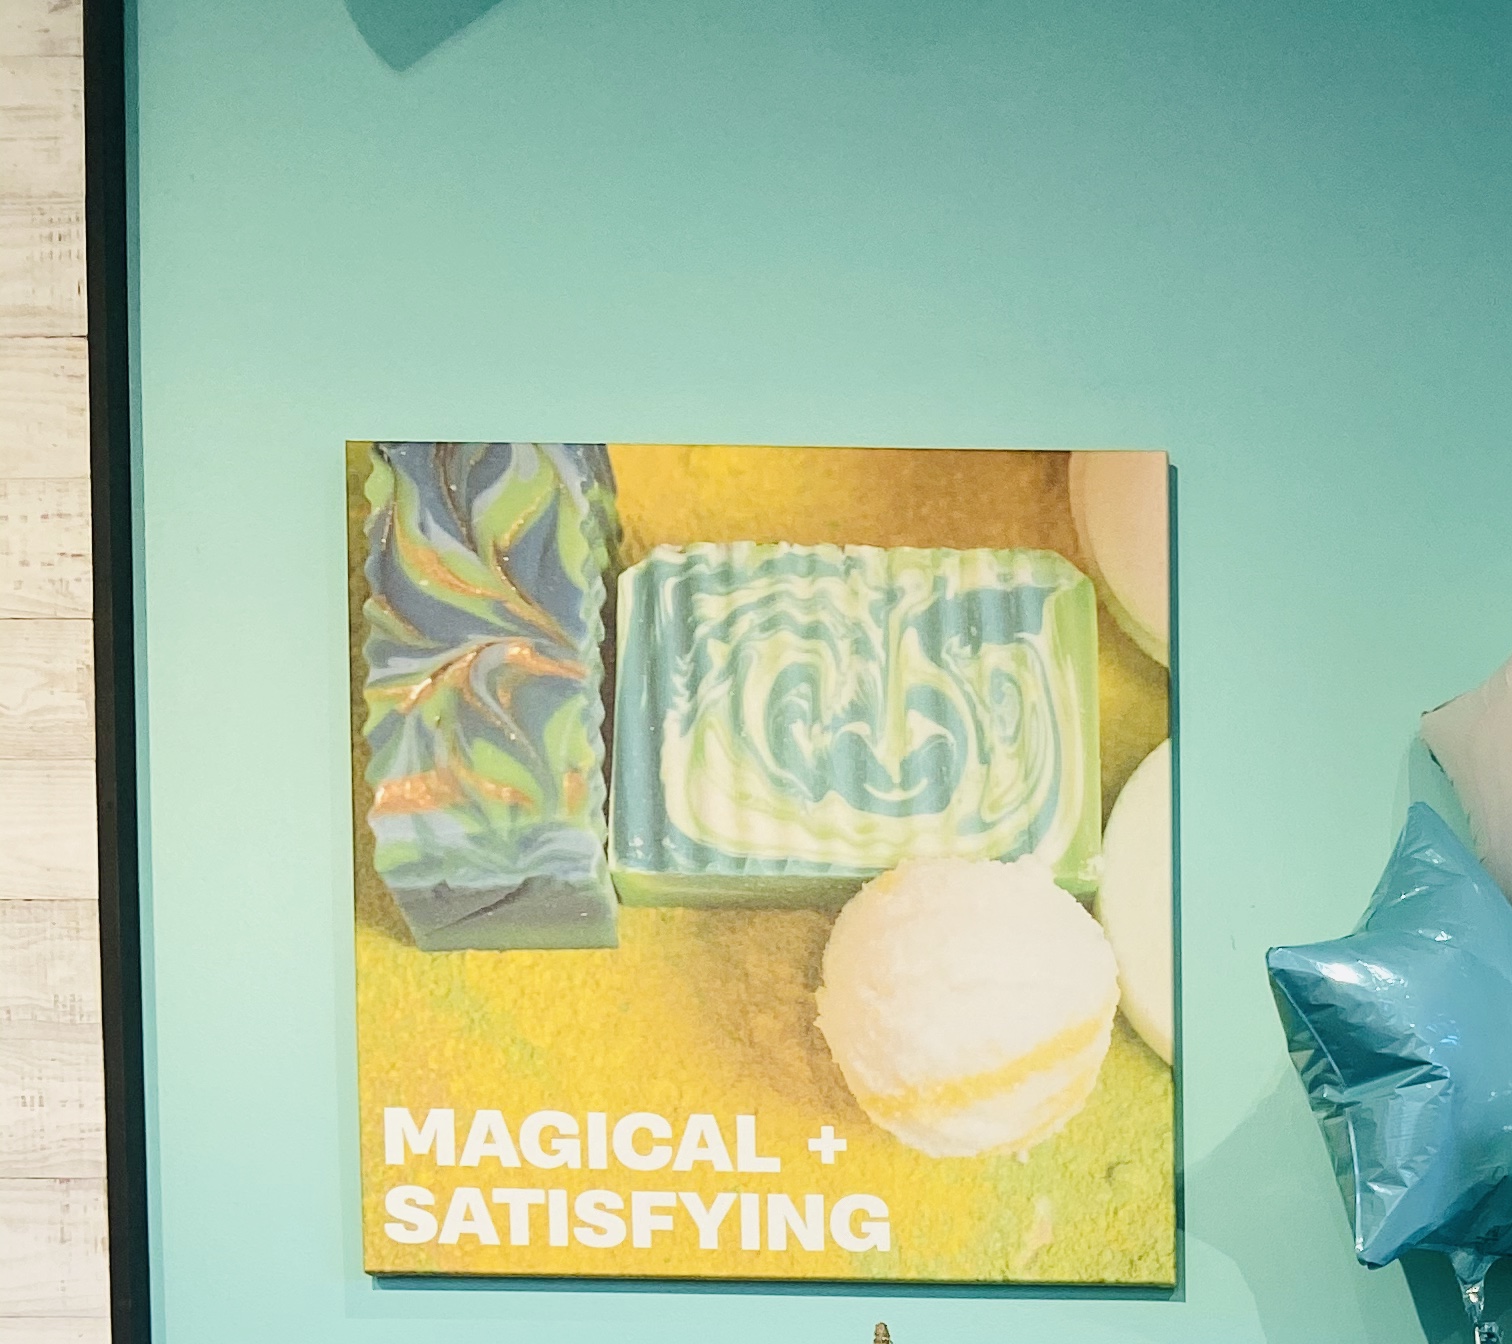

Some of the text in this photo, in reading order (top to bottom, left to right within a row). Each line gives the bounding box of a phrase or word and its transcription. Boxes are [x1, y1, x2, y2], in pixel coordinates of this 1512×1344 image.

[383, 1107, 847, 1173] MAGICAL +
[383, 1185, 891, 1253] SATISFYING
